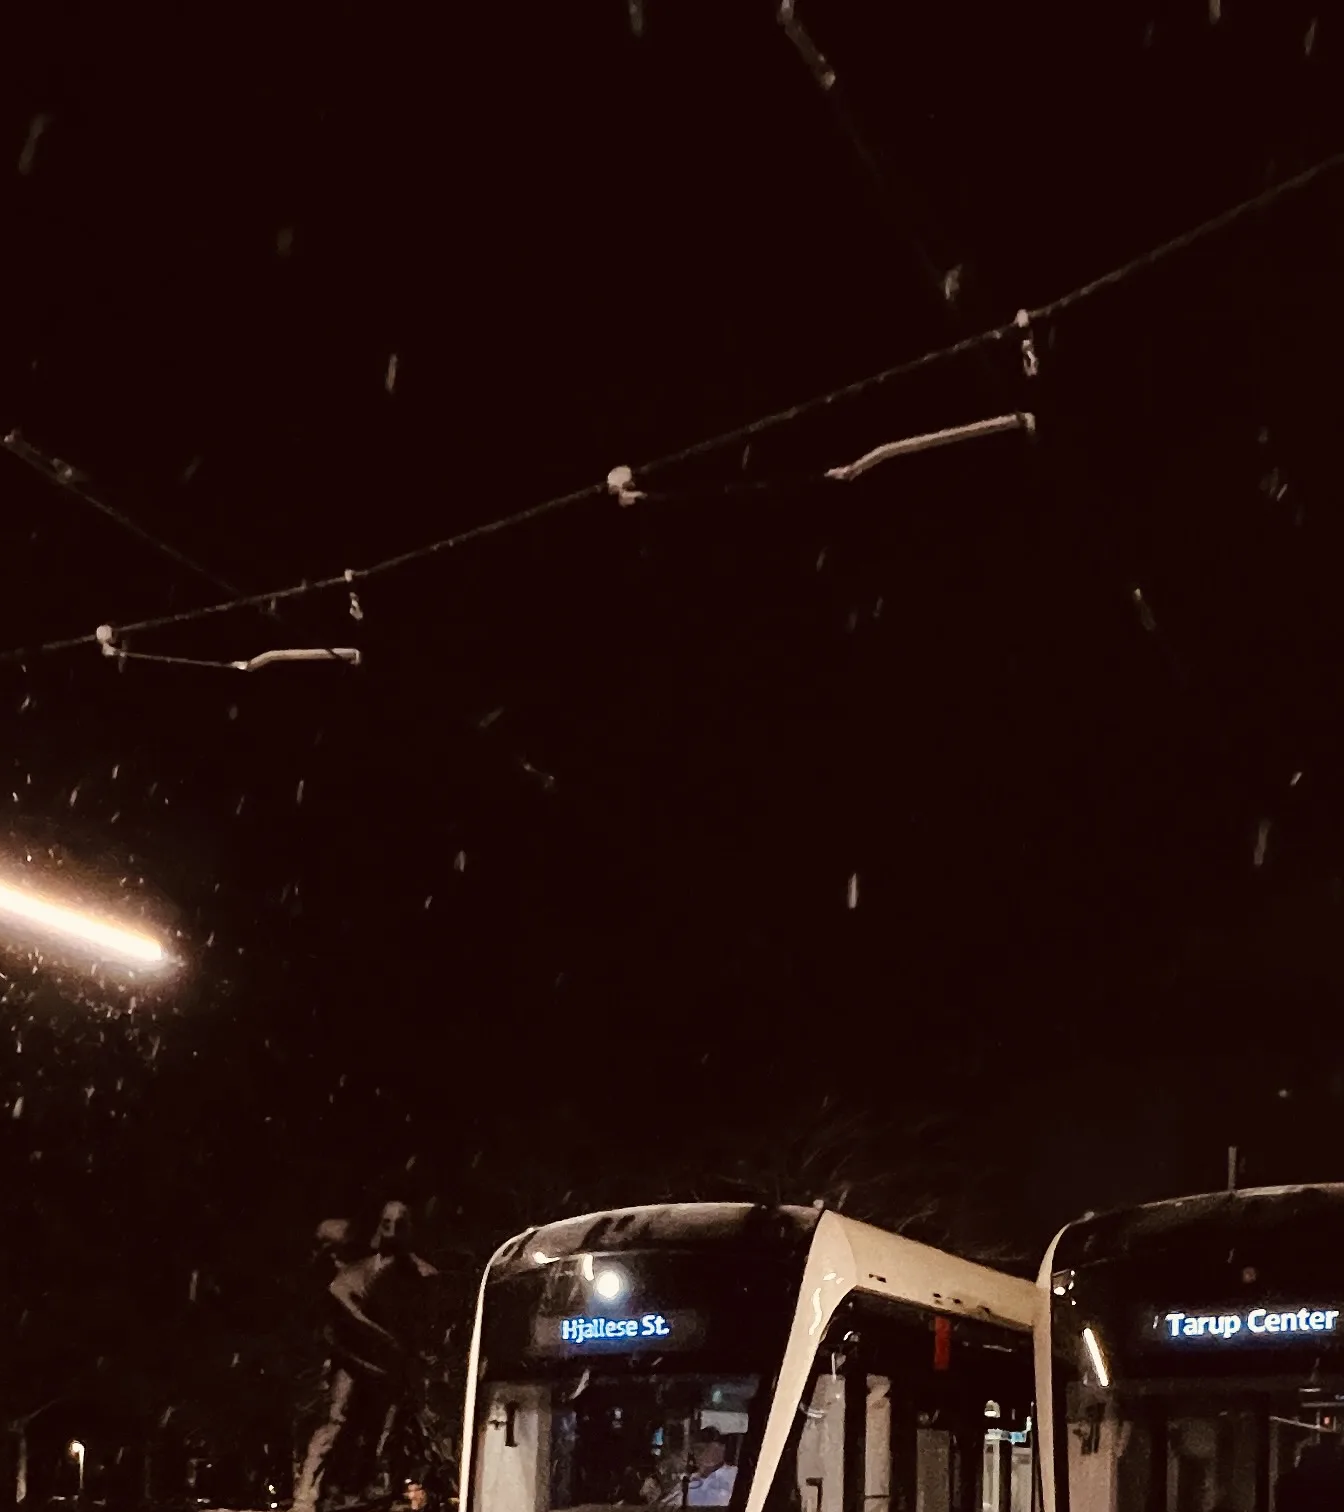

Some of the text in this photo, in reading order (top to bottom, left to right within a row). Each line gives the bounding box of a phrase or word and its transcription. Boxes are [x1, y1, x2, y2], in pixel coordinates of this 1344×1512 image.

[562, 1314, 670, 1343] Hjallese St.
[1165, 1307, 1340, 1339] Tarup Center
